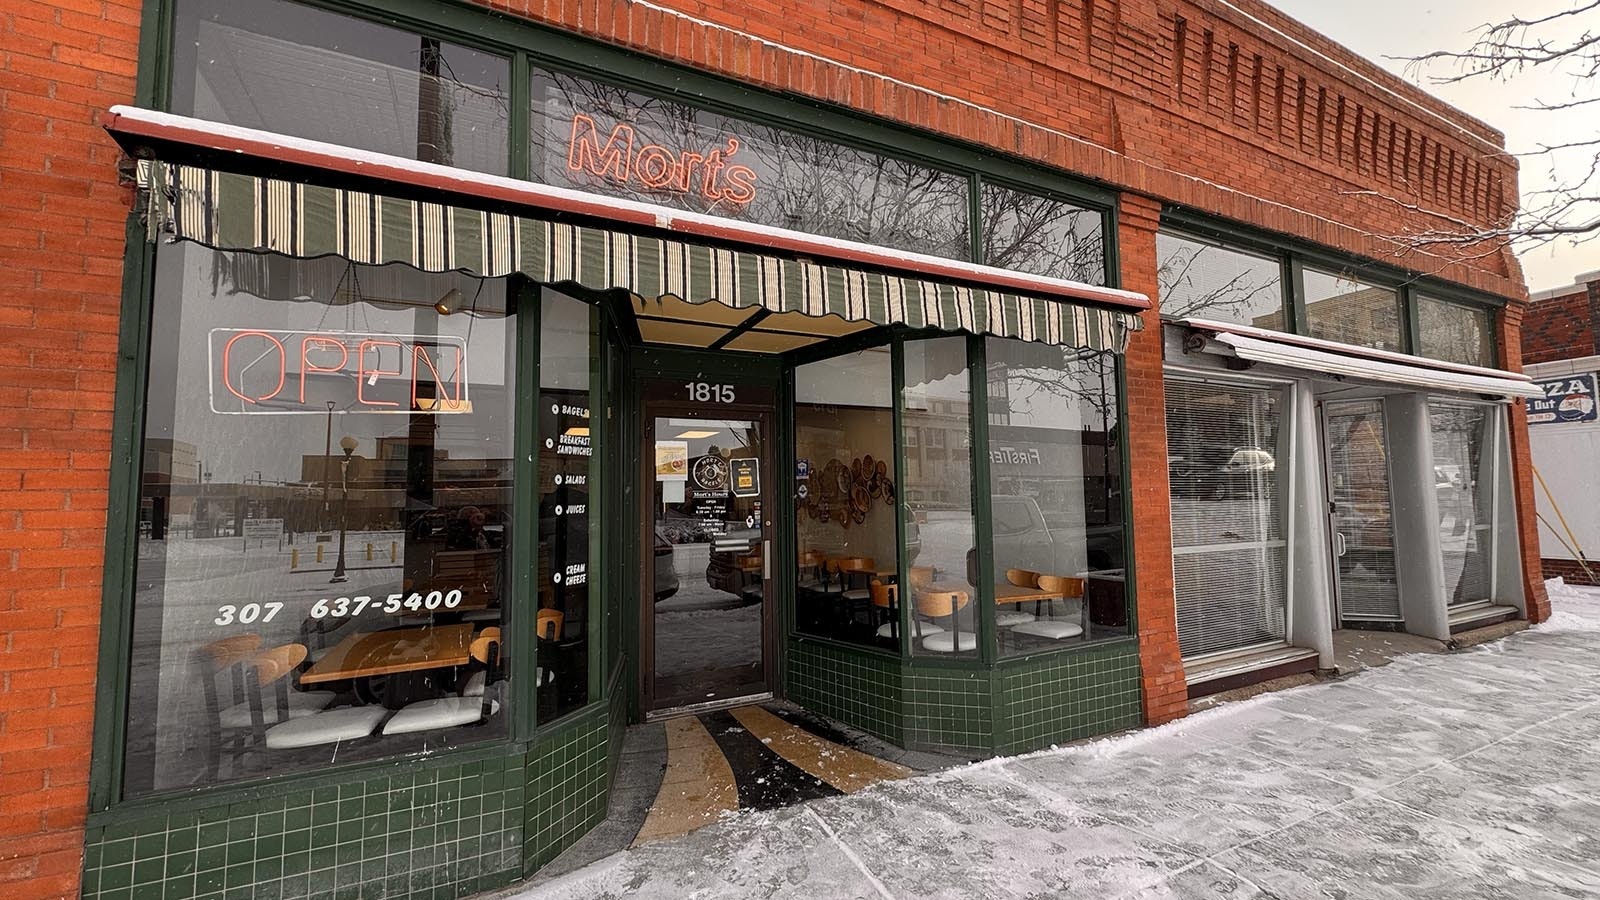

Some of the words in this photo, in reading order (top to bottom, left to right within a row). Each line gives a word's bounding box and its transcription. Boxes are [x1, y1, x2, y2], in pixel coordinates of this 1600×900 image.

[568, 114, 757, 204] Mort's
[222, 330, 462, 410] OPEN
[685, 382, 736, 404] 1815
[1534, 399, 1556, 411] Out
[559, 434, 591, 446] BREAKFAST
[556, 445, 593, 457] SANDWICHES
[564, 474, 586, 485] SALADS
[565, 504, 586, 515] JUICES
[565, 563, 586, 574] CREAM
[565, 573, 587, 587] CHEESE
[213, 601, 284, 627] 307
[309, 587, 464, 621] 637-5400
